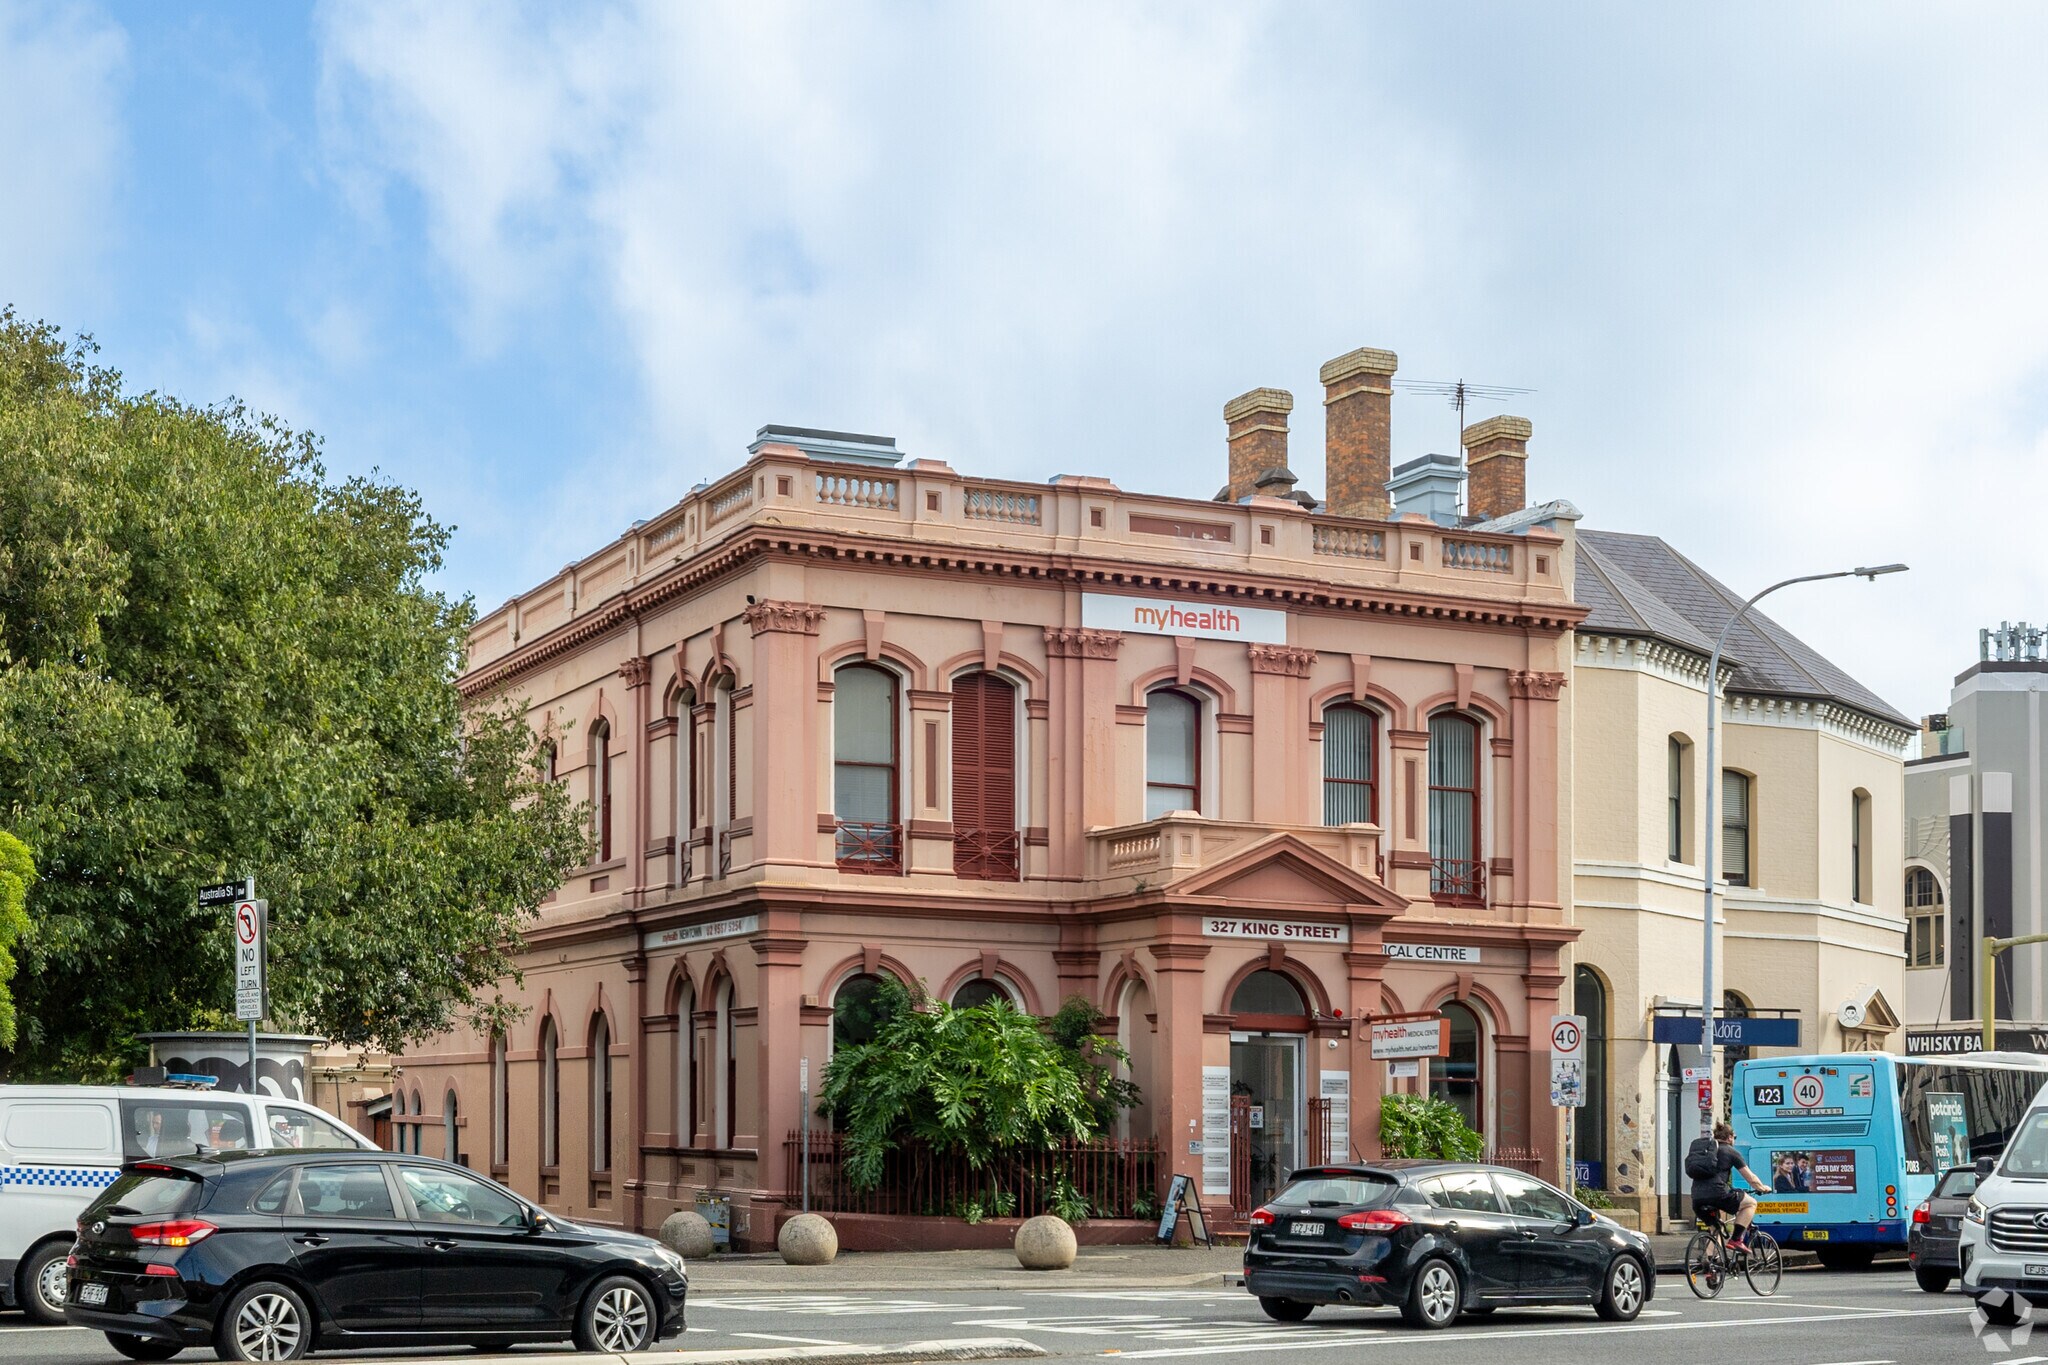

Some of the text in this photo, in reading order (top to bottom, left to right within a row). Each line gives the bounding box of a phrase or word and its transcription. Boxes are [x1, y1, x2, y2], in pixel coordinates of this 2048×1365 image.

[1134, 605, 1240, 632] myhealth
[200, 887, 225, 900] Australia
[226, 885, 234, 897] St
[1211, 921, 1341, 939] 327 KING STREET
[242, 948, 255, 962] NO
[1382, 944, 1467, 961] ICAL CENTRE
[240, 966, 256, 976] LEFT
[240, 980, 257, 989] TURN
[1373, 1026, 1407, 1042] myhealth
[1556, 1029, 1576, 1044] 40
[1908, 1036, 1961, 1052] WHISKY
[1758, 1088, 1781, 1104] 423
[1800, 1085, 1816, 1099] 40
[1930, 1100, 1962, 1120] petcircle
[1934, 1132, 1948, 1143] More
[1815, 1164, 1829, 1172] OPEN
[1830, 1164, 1840, 1172] DAY
[1906, 1160, 1920, 1172] 7083
